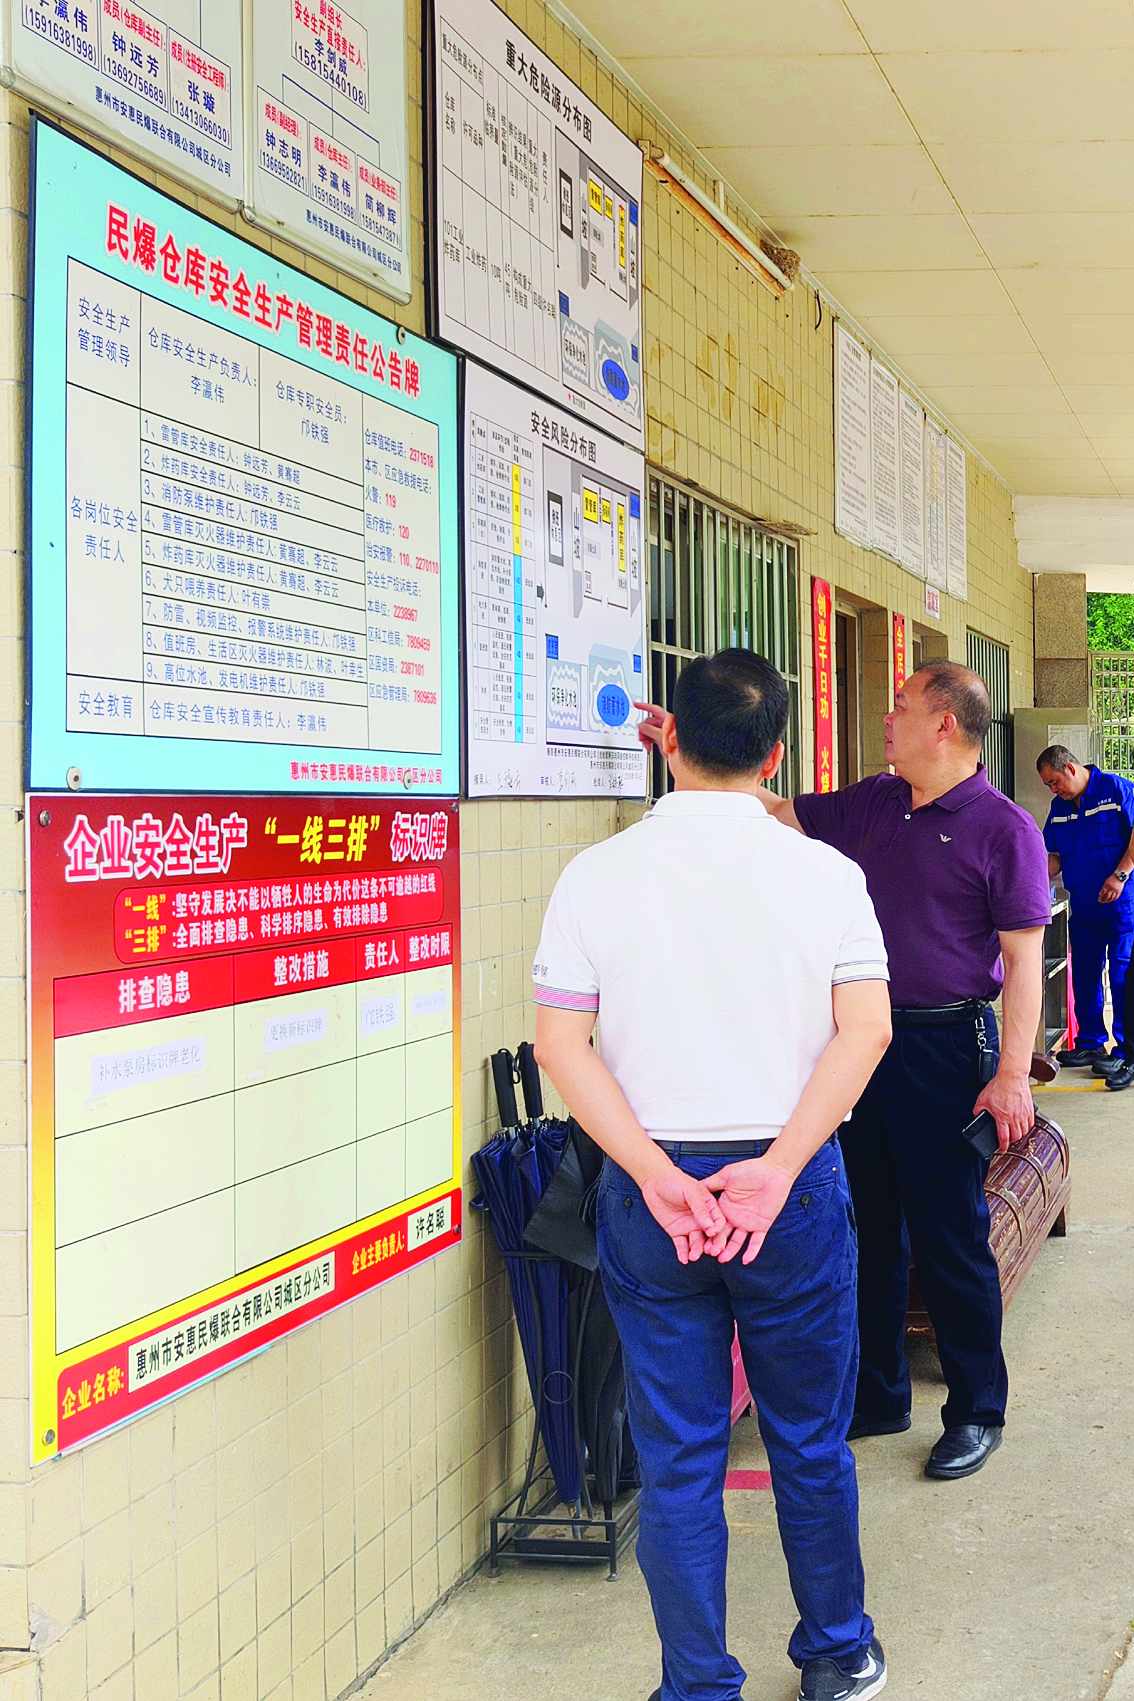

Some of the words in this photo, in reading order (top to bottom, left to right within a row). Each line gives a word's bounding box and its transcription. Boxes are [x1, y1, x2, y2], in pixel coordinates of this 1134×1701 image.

[25, 5, 96, 66] (15916381998)
[112, 31, 160, 78] 钟远芳
[103, 54, 167, 109] (13692756689)
[294, 41, 367, 110] (15815440108)
[504, 38, 592, 144] 重大危险源分布图
[171, 97, 231, 147] (13413066030)
[265, 129, 302, 168] 钟志明
[78, 297, 130, 334] 安全生产
[106, 204, 420, 399] 民爆仓库安全生产管理责任公告牌
[78, 328, 130, 368] 管理领导
[148, 326, 257, 388] 仓库安全生产负责人：
[275, 380, 347, 424] 仓库专职安全员：
[530, 410, 597, 464] 安全风险分布图
[70, 494, 138, 534] 各岗位安全
[85, 534, 125, 563] 责任人
[817, 592, 829, 719] 创业千日功
[78, 692, 133, 719] 安全教育
[64, 811, 248, 882] 企业安全生产
[265, 815, 381, 864] “一线三排”
[389, 811, 449, 862] 标识牌
[273, 949, 330, 987] 整改措施
[364, 939, 400, 971] 责任人
[408, 932, 451, 962] 整改时限
[118, 970, 191, 1014] 排查隐患
[98, 1044, 201, 1083] 补水泵房标识牌老化
[352, 1230, 405, 1275] 企业主要负责人：
[135, 1261, 332, 1381] 惠州市安惠民爆联合有限公司城区分公司
[61, 1366, 125, 1420] 企业名称：
